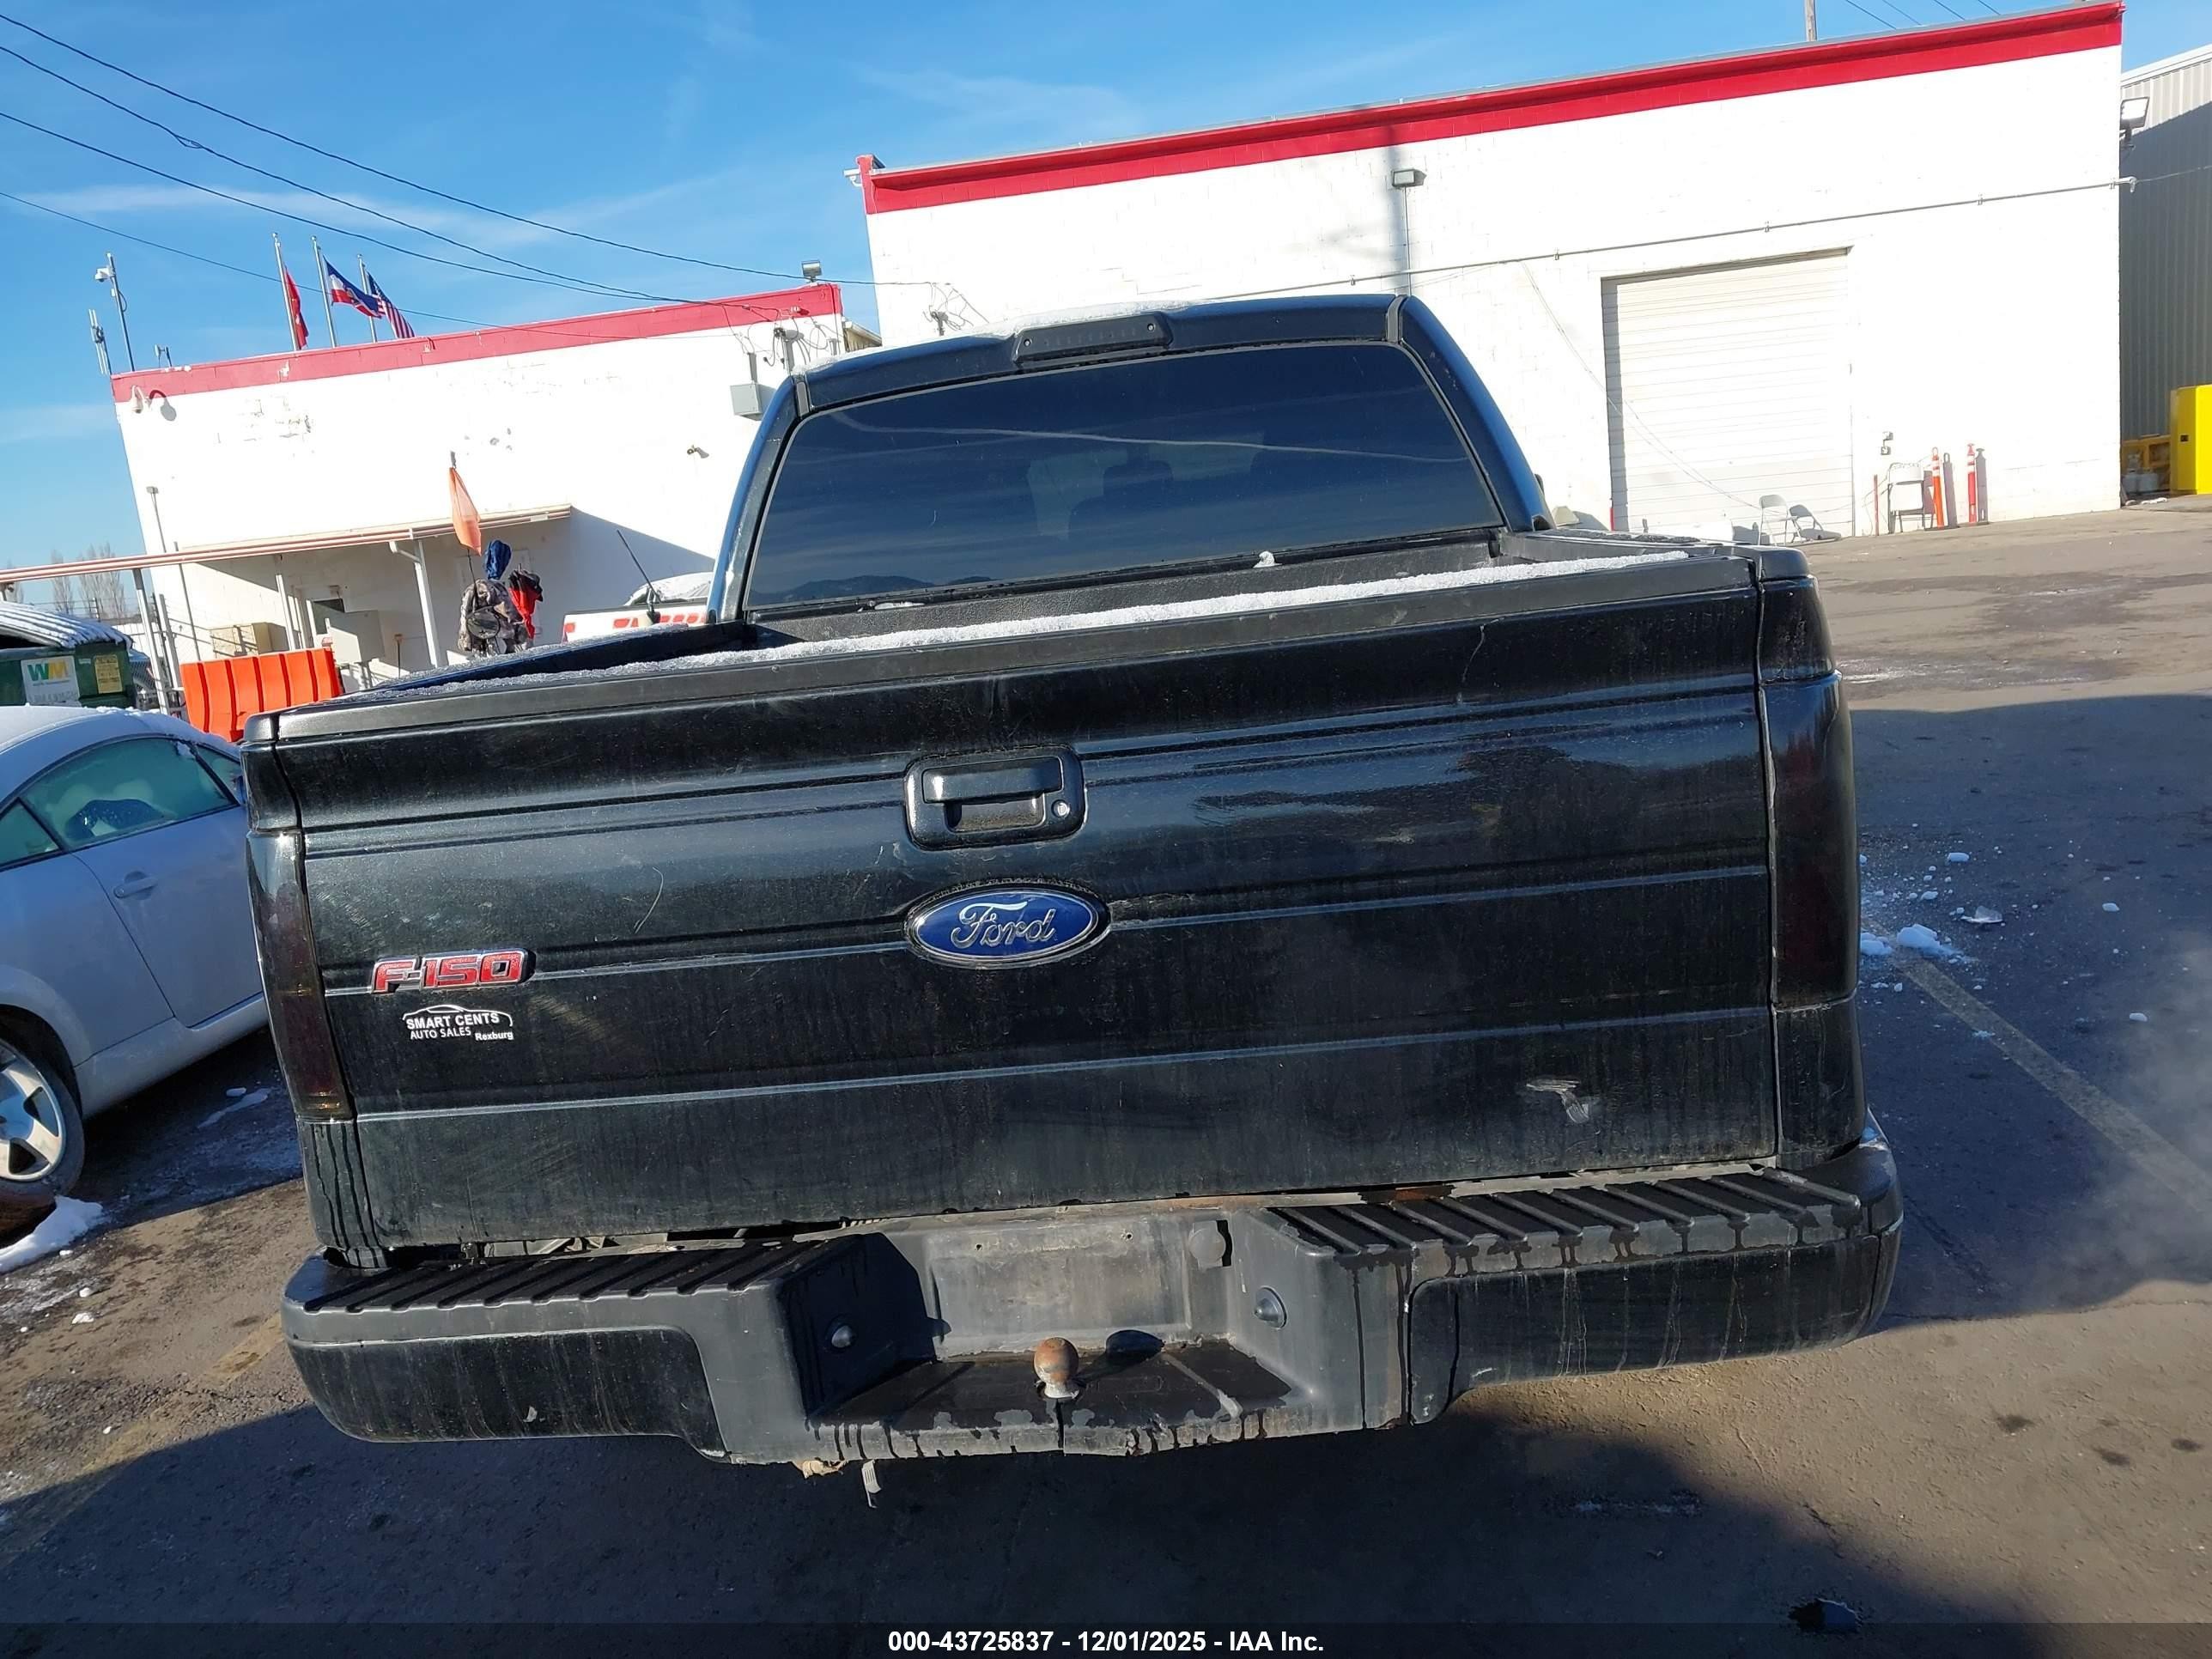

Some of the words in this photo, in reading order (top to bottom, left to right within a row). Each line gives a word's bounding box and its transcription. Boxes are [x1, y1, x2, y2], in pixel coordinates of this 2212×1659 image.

[27, 659, 70, 681] WM
[951, 902, 1057, 948] Ford
[371, 951, 526, 994] F-150
[405, 1016, 451, 1030] SMART
[455, 1012, 500, 1026] CENTS
[410, 1030, 438, 1040] AUTO
[440, 1026, 471, 1038] SALES
[475, 1031, 514, 1041] Rexburg
